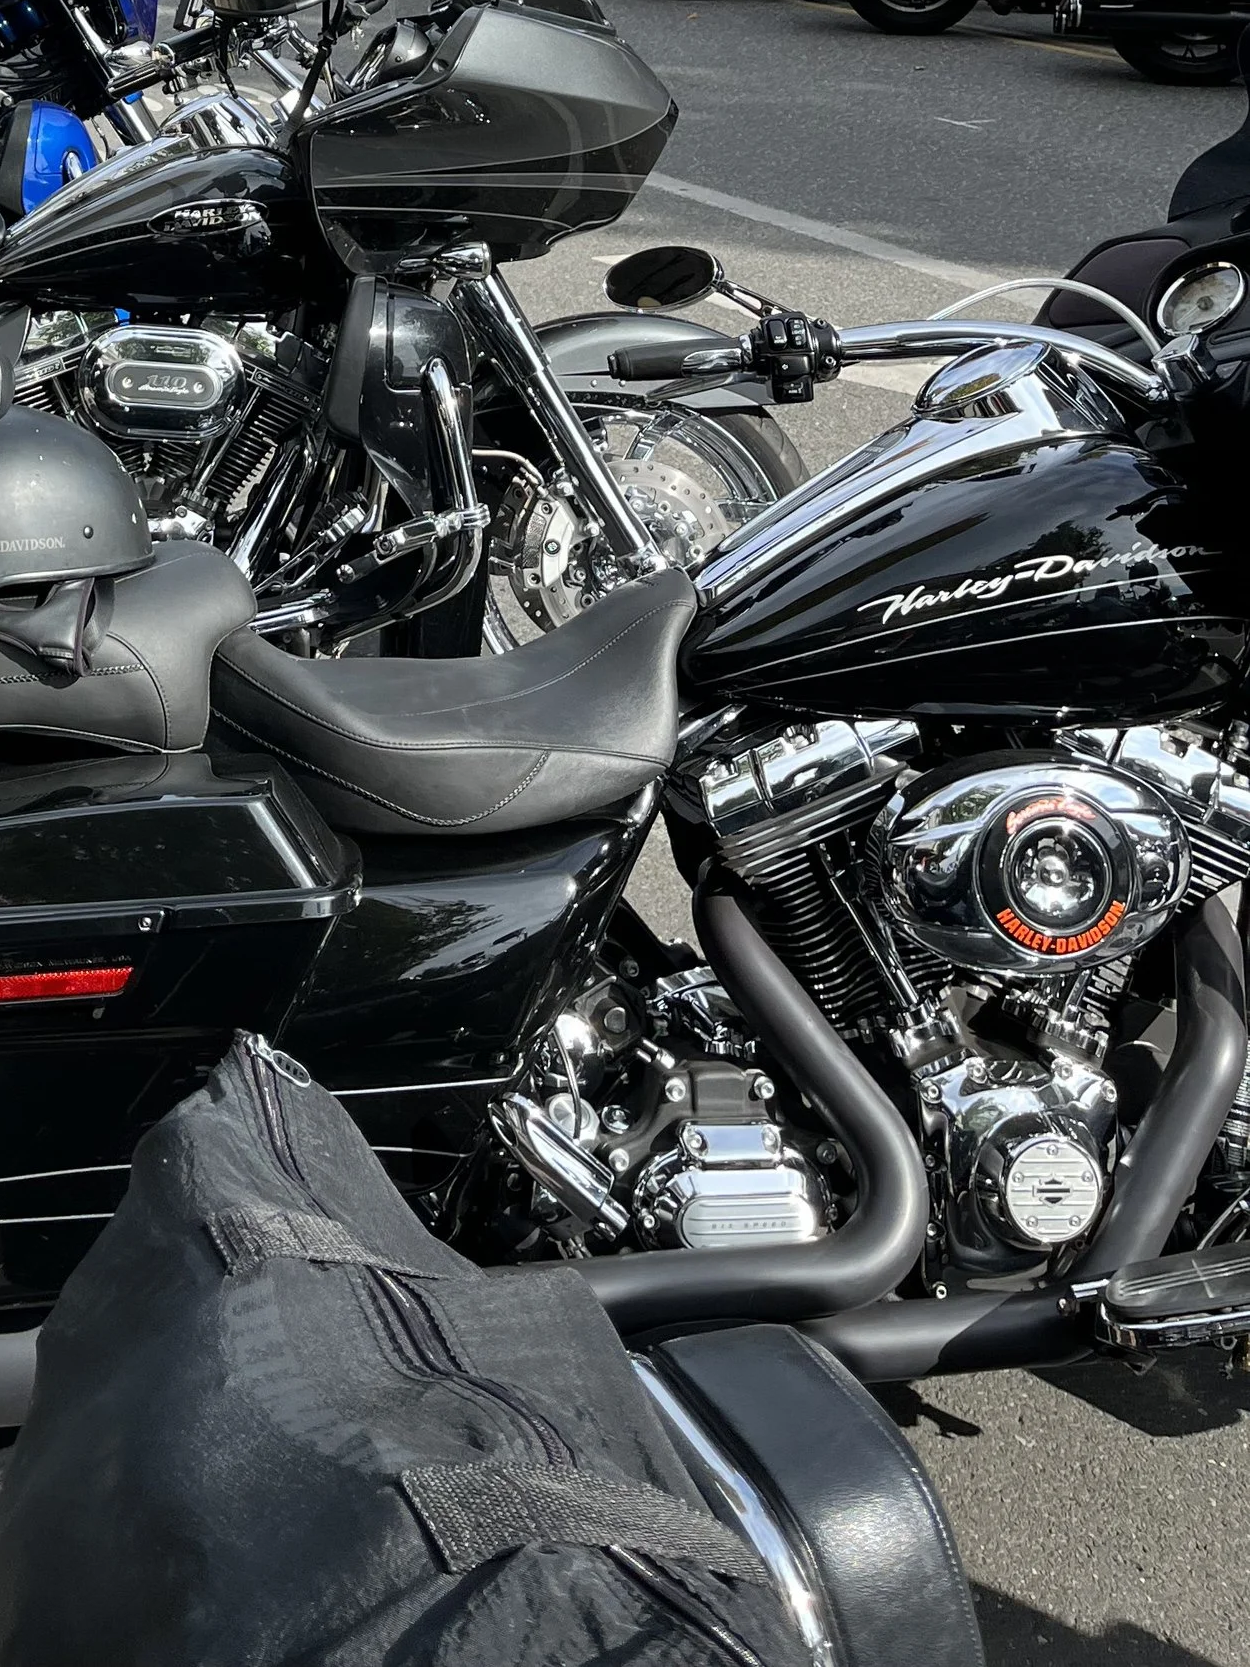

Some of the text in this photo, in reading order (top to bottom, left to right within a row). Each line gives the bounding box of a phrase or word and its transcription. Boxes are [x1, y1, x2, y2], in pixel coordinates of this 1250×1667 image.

[146, 375, 187, 387] 110
[857, 542, 1222, 625] Harley-Davidson
[996, 900, 1126, 954] HARLEY-DAVIDSON
